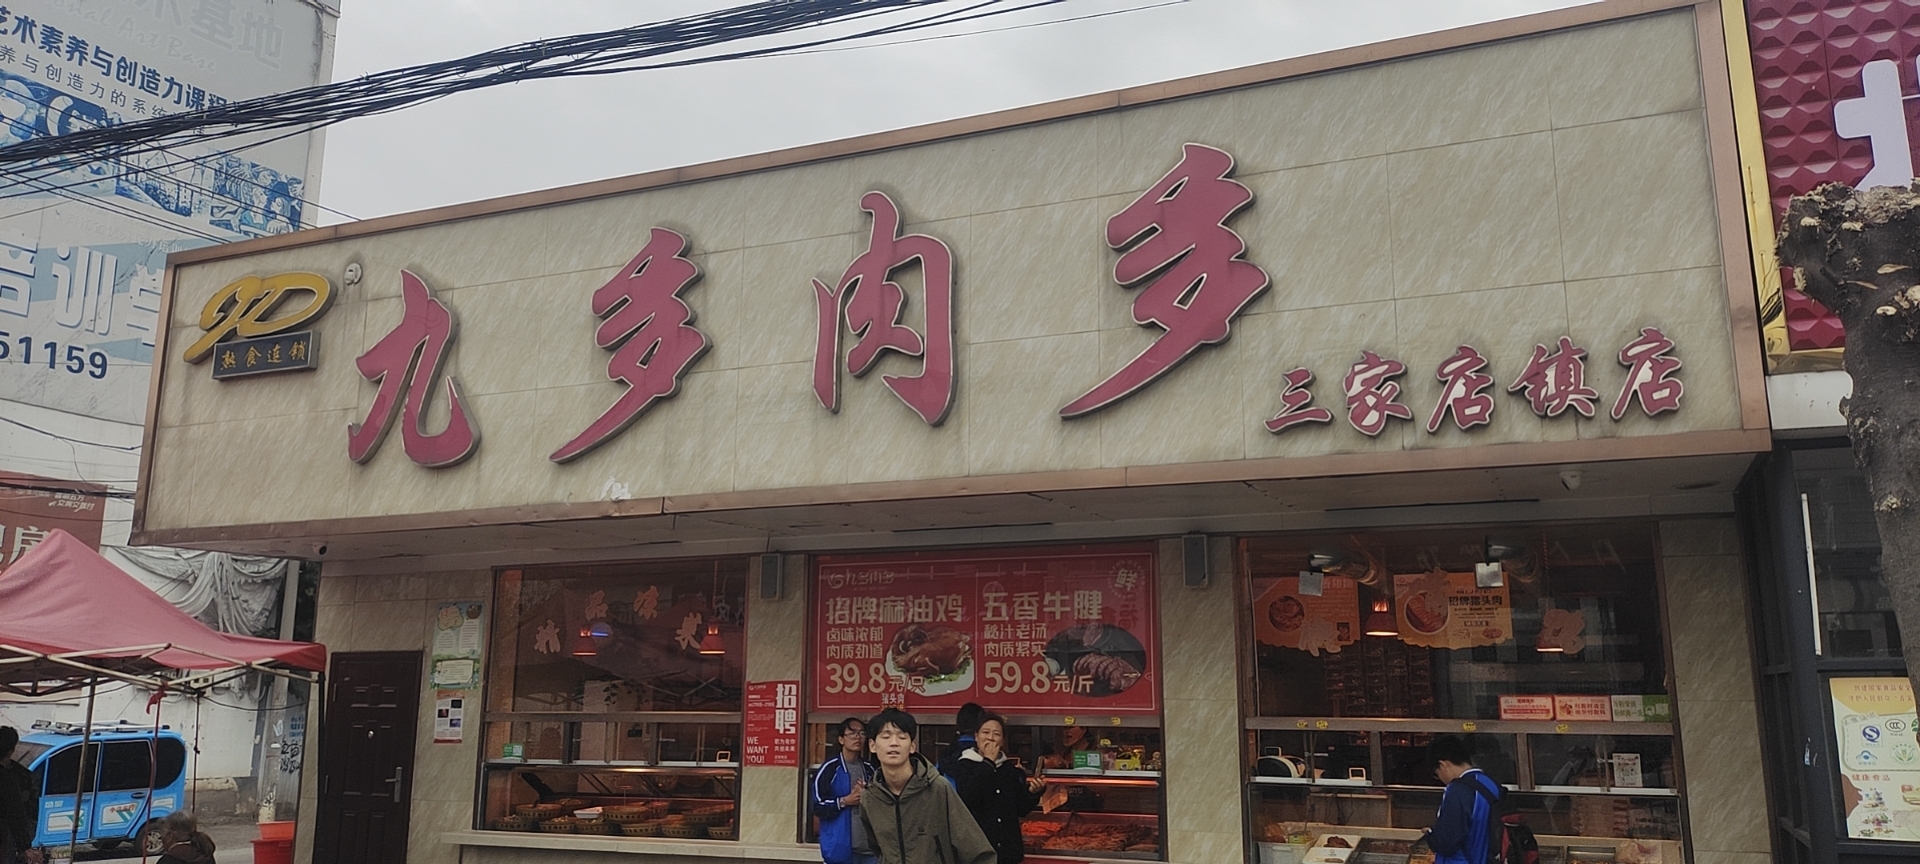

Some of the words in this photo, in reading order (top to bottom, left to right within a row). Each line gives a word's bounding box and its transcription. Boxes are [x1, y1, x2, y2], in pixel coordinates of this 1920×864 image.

[349, 143, 1271, 468] 九多肉多
[220, 341, 307, 370] 熟食连锁
[1264, 327, 1684, 436] 三家店镇店
[0, 524, 50, 566] 房
[1114, 568, 1138, 591] 鲜
[825, 594, 964, 624] 招牌麻油鸡
[982, 590, 1102, 621] 五香牛腱
[827, 626, 884, 642] 卤味浓郁
[984, 624, 1047, 640] 秘汁老汤
[827, 644, 884, 660] 肉质劲道
[984, 642, 1047, 657] 肉质紧实
[775, 683, 797, 734] 招聘
[747, 736, 759, 744] WE
[747, 746, 769, 754] WANT
[746, 755, 765, 764] YOU!
